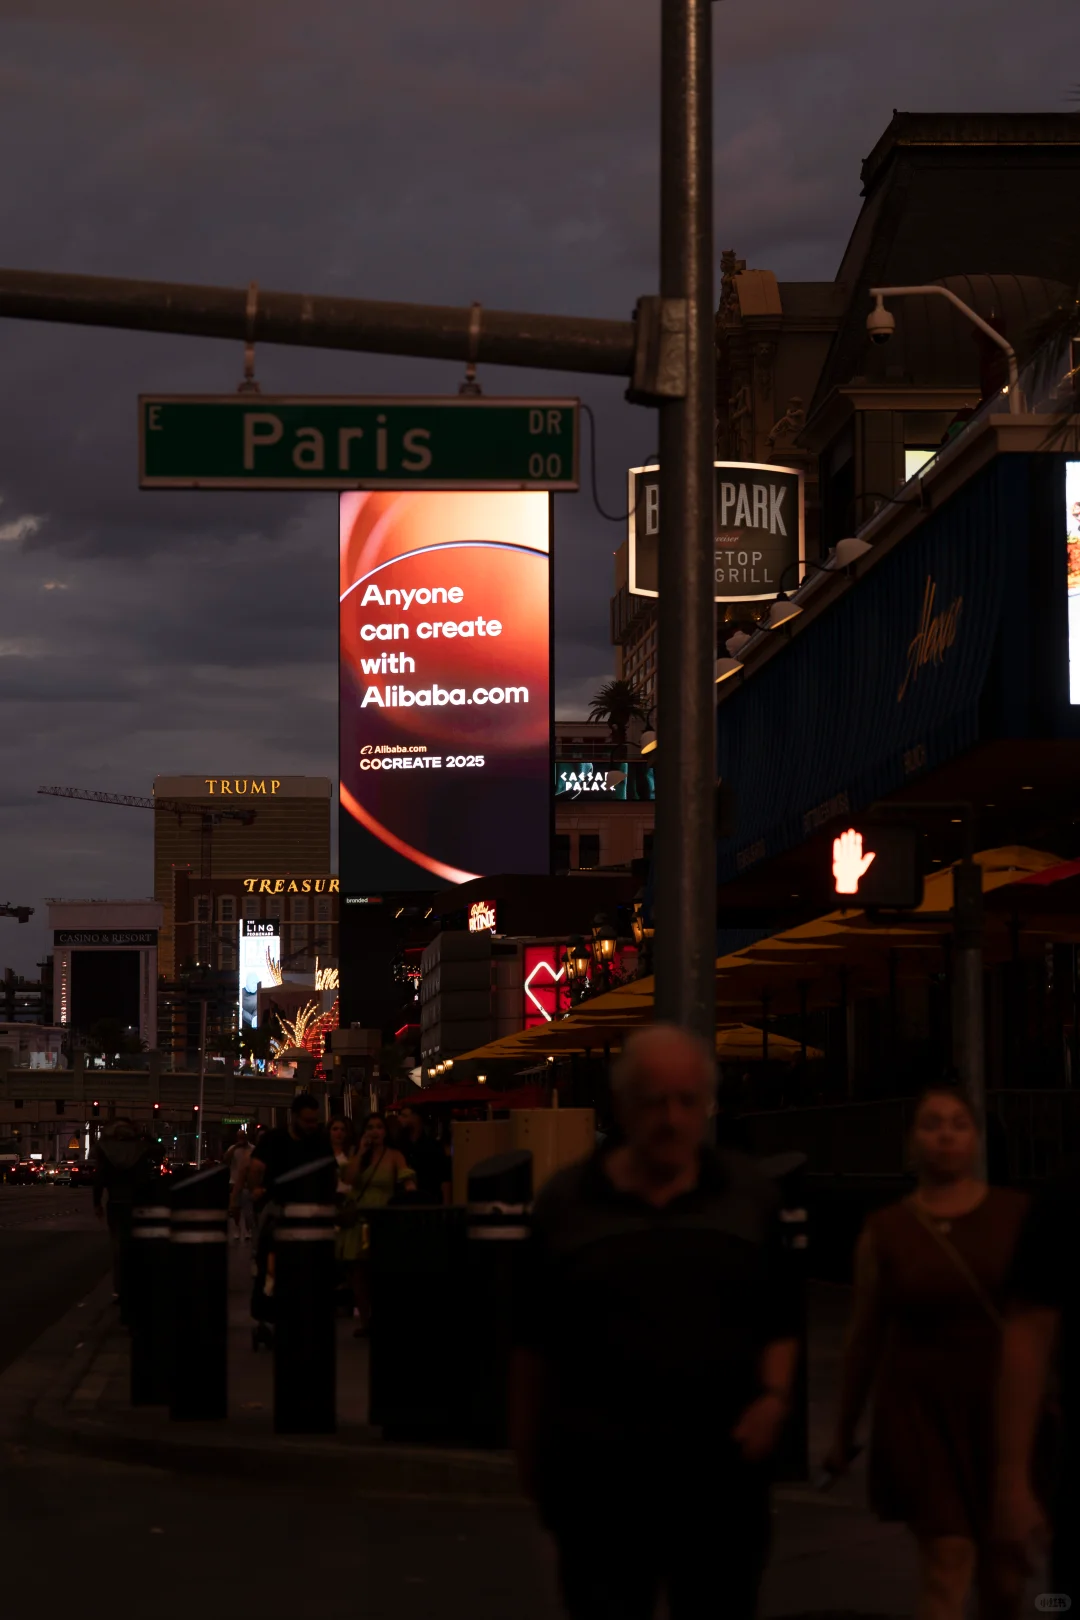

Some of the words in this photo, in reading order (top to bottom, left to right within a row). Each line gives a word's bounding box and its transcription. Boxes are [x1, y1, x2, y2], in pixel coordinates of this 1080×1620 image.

[149, 406, 164, 430] E
[528, 410, 562, 435] DR
[243, 412, 432, 473] Paris
[720, 482, 788, 536] PARK
[714, 568, 774, 583] GRILL
[360, 584, 464, 611] Anyone
[360, 623, 409, 641] can
[416, 616, 503, 639] create
[361, 652, 416, 674] with
[360, 684, 529, 708] Alibaba.com
[374, 745, 427, 754] Alibaba.com
[360, 757, 442, 770] COCREATE
[446, 755, 485, 768] 2025
[205, 779, 281, 795] TRUMP
[243, 878, 340, 895] TREASUR
[59, 933, 99, 943] CASINO
[102, 934, 109, 943] &
[112, 933, 153, 943] RESORT
[246, 924, 274, 932] LINQ
